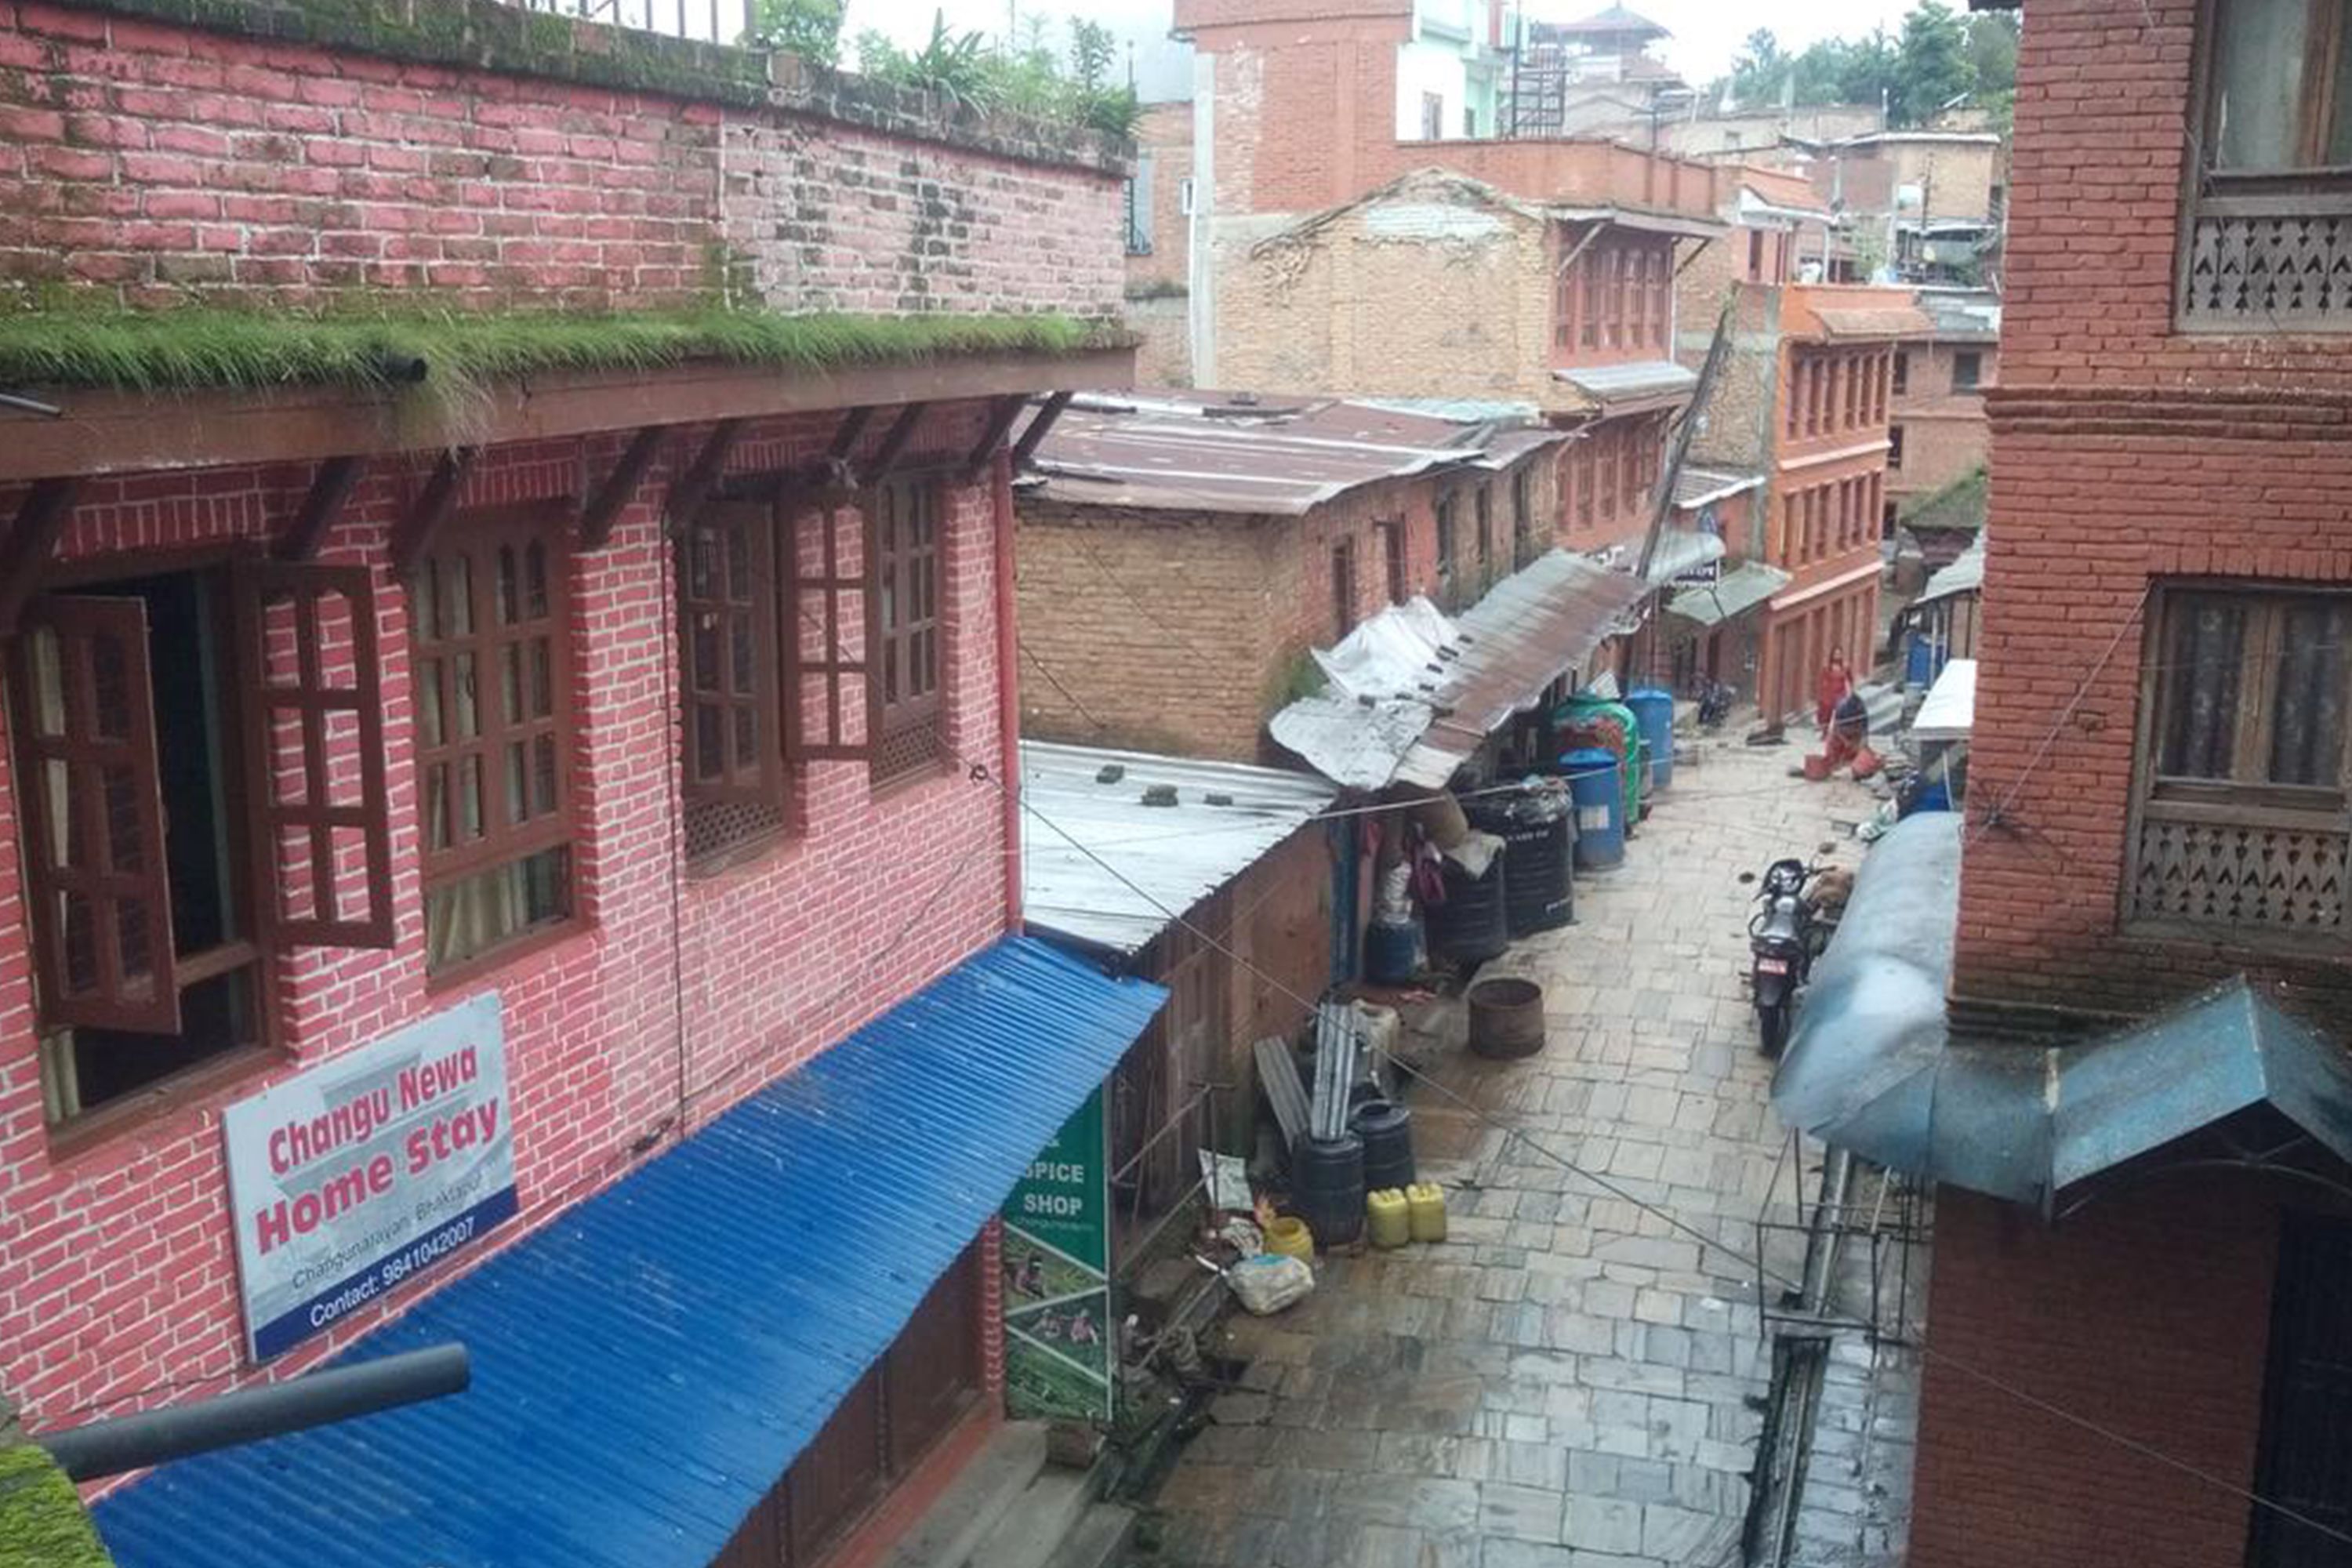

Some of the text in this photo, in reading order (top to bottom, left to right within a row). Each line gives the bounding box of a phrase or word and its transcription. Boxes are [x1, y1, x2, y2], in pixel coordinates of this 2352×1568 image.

[269, 1046, 477, 1175] Changu Newa
[256, 1155, 394, 1254] Home
[1025, 1192, 1083, 1216] SHOP
[310, 1216, 474, 1327] Contact: 9841042007
